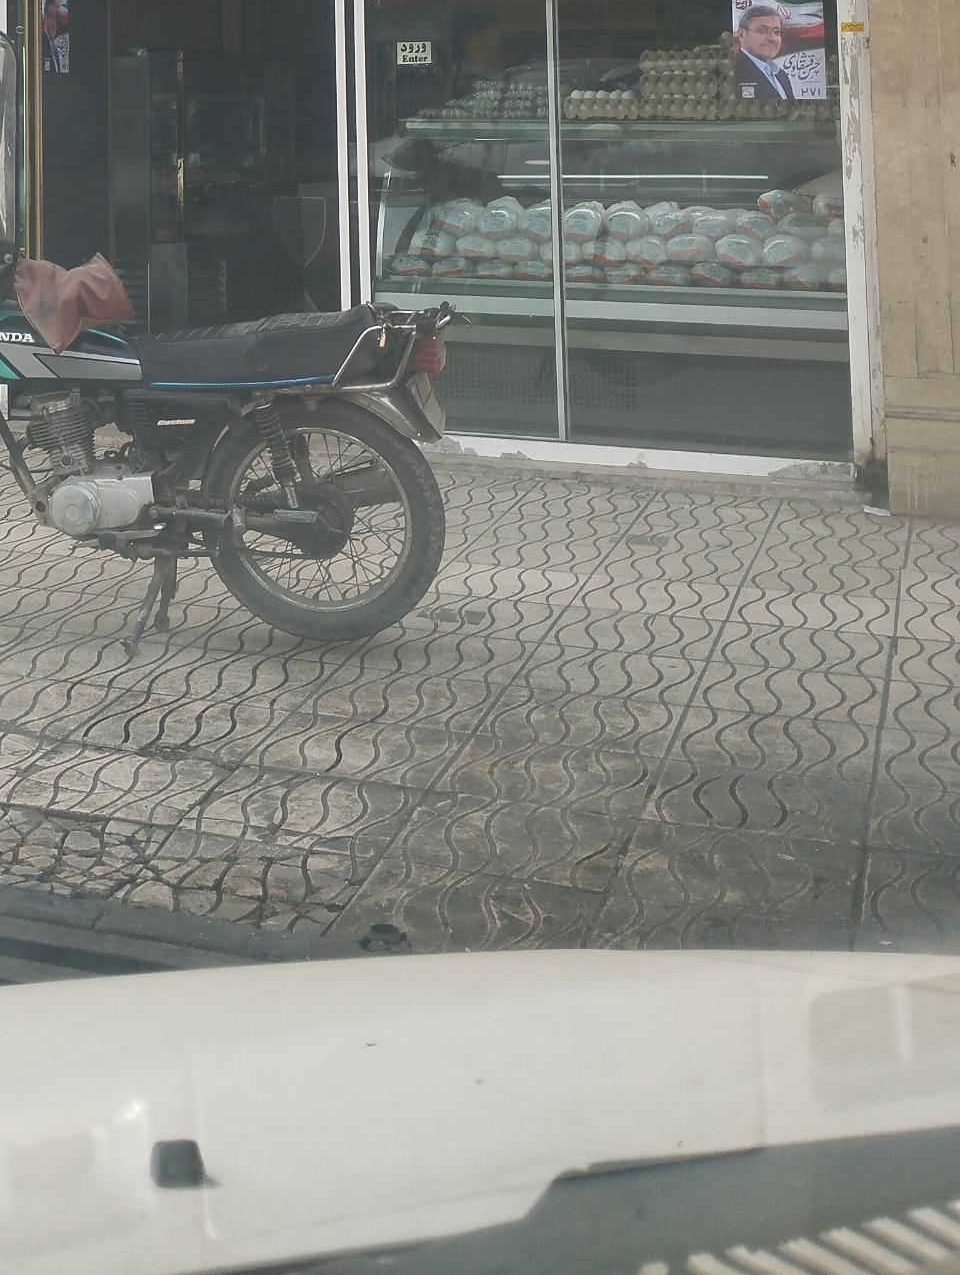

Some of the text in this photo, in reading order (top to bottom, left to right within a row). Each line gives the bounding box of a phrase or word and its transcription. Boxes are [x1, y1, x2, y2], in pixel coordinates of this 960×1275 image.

[400, 42, 427, 53] ورود
[402, 55, 428, 63] Enter
[801, 87, 821, 97] ۲۷۱
